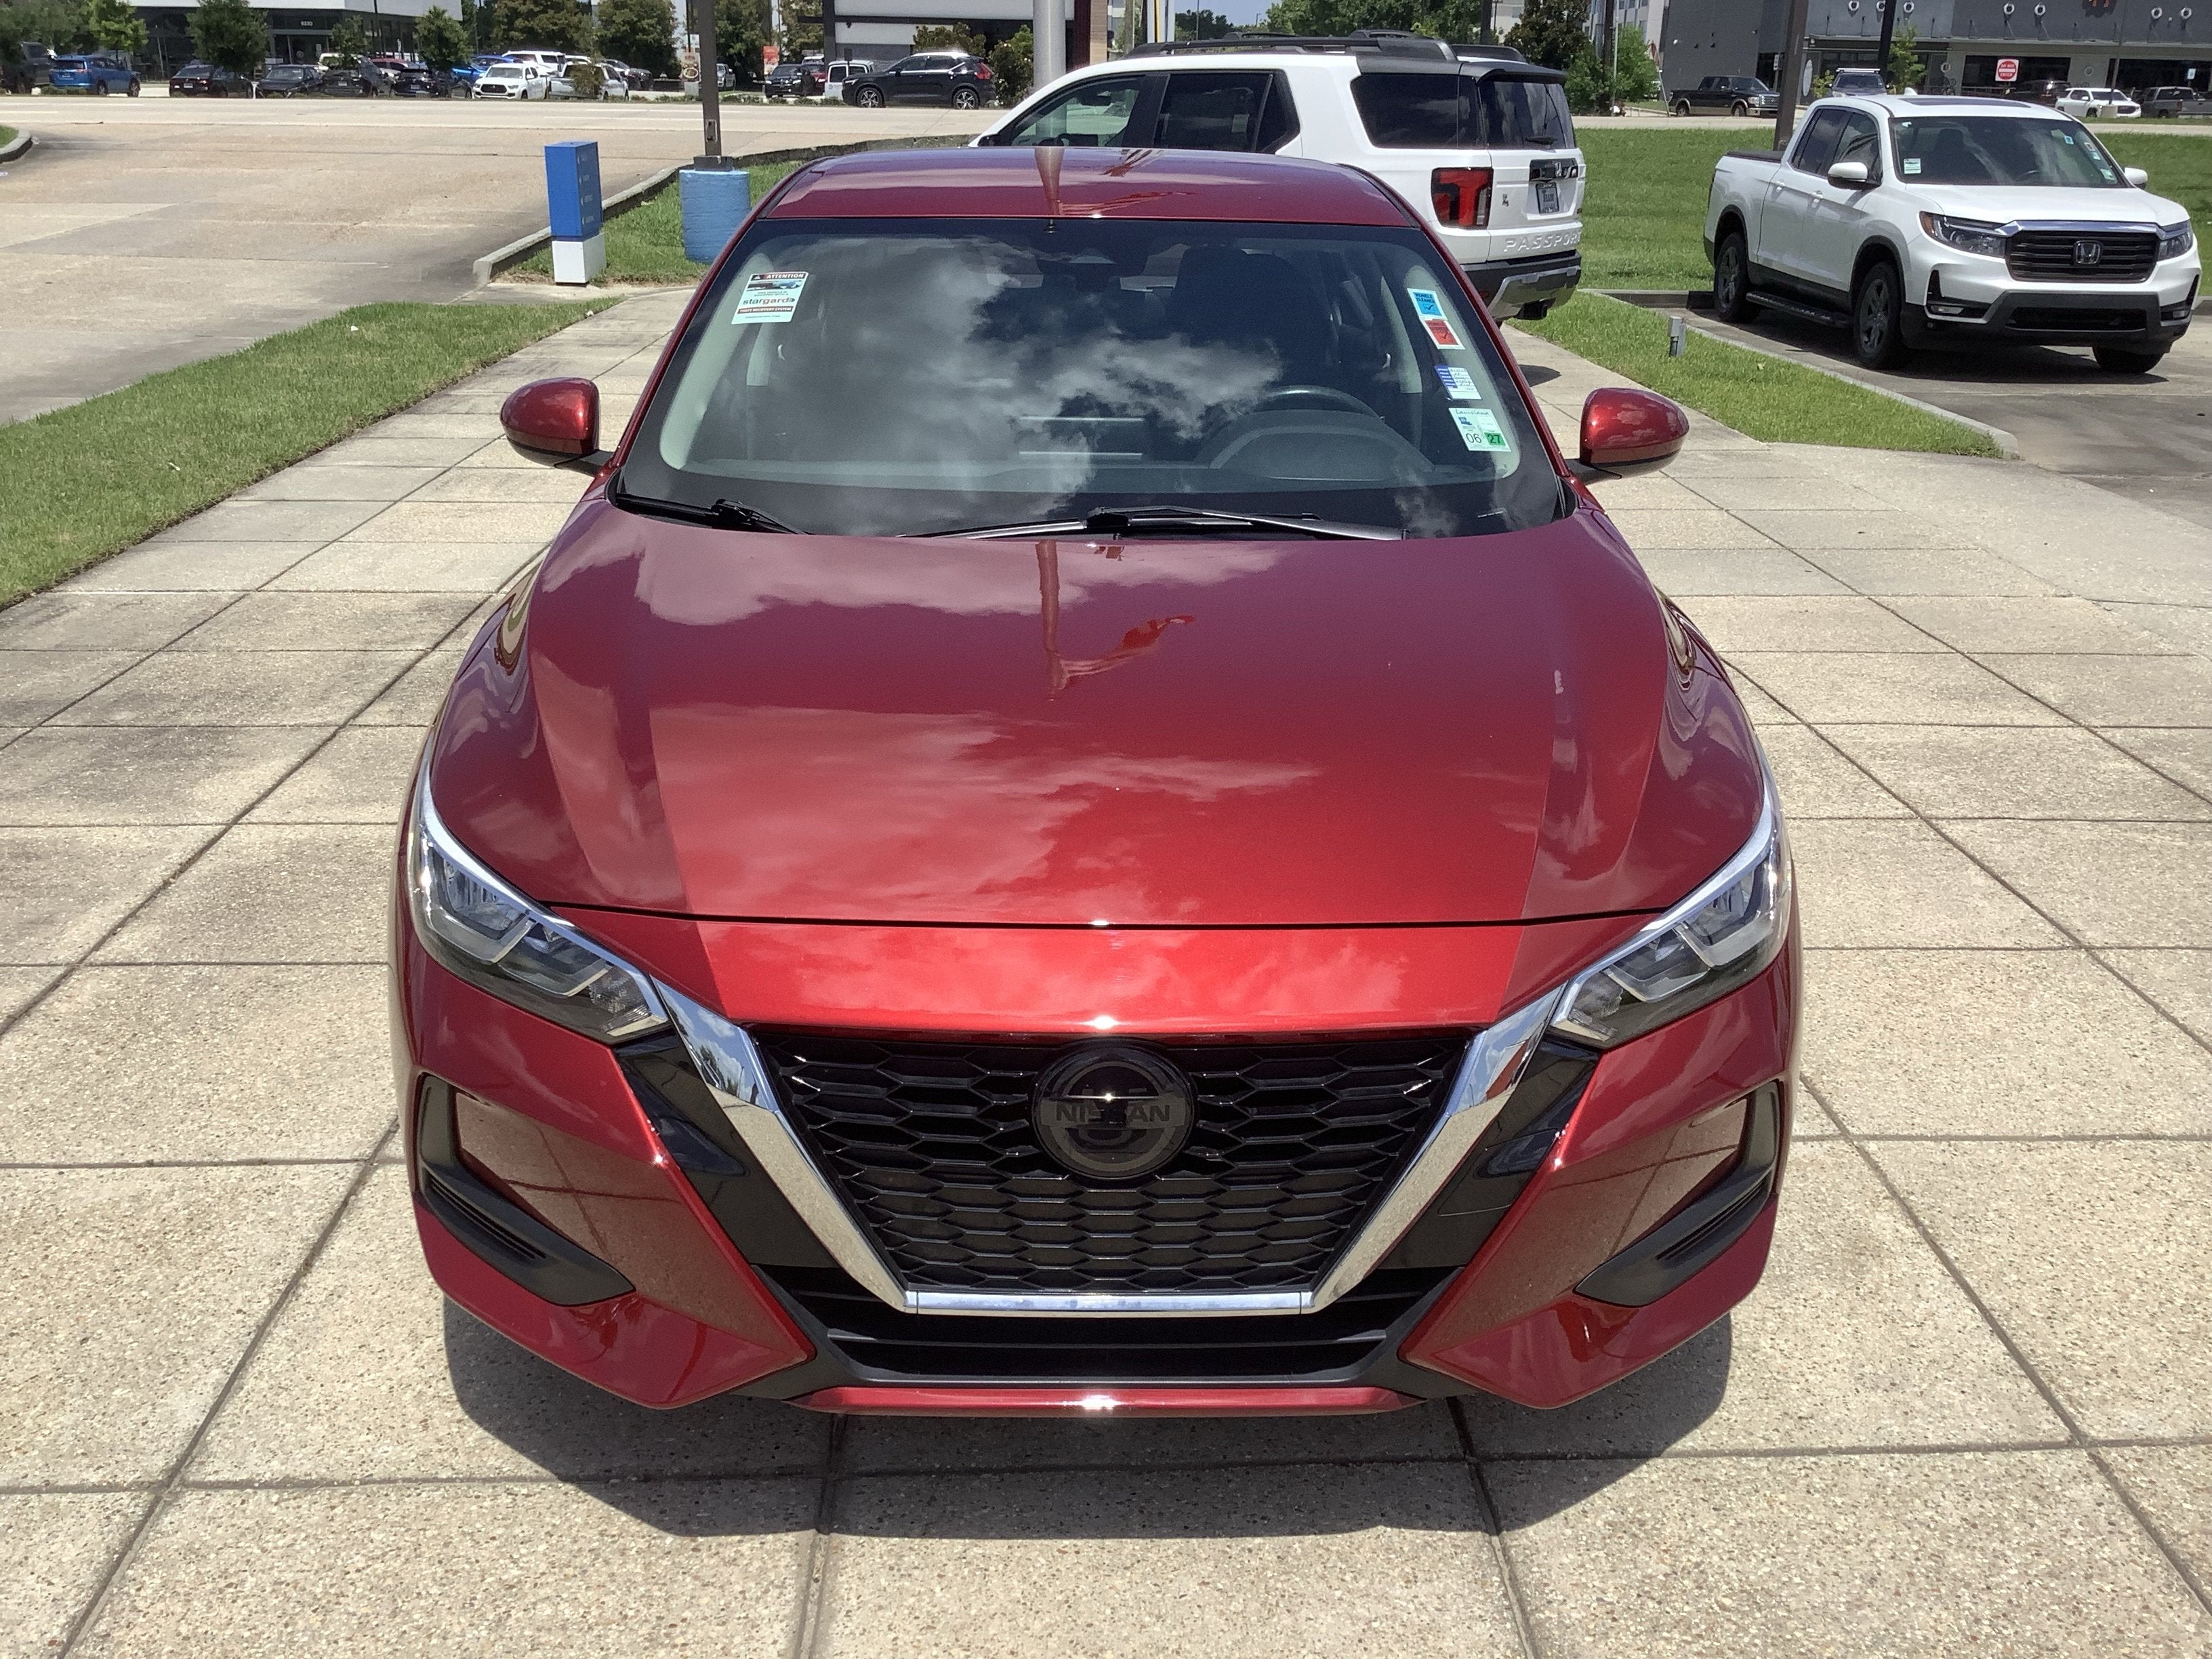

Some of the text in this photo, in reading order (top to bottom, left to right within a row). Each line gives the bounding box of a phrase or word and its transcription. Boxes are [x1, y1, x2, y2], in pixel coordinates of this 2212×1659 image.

[1466, 433, 1501, 444] 06 27
[1055, 1104, 1170, 1122] NISAN
